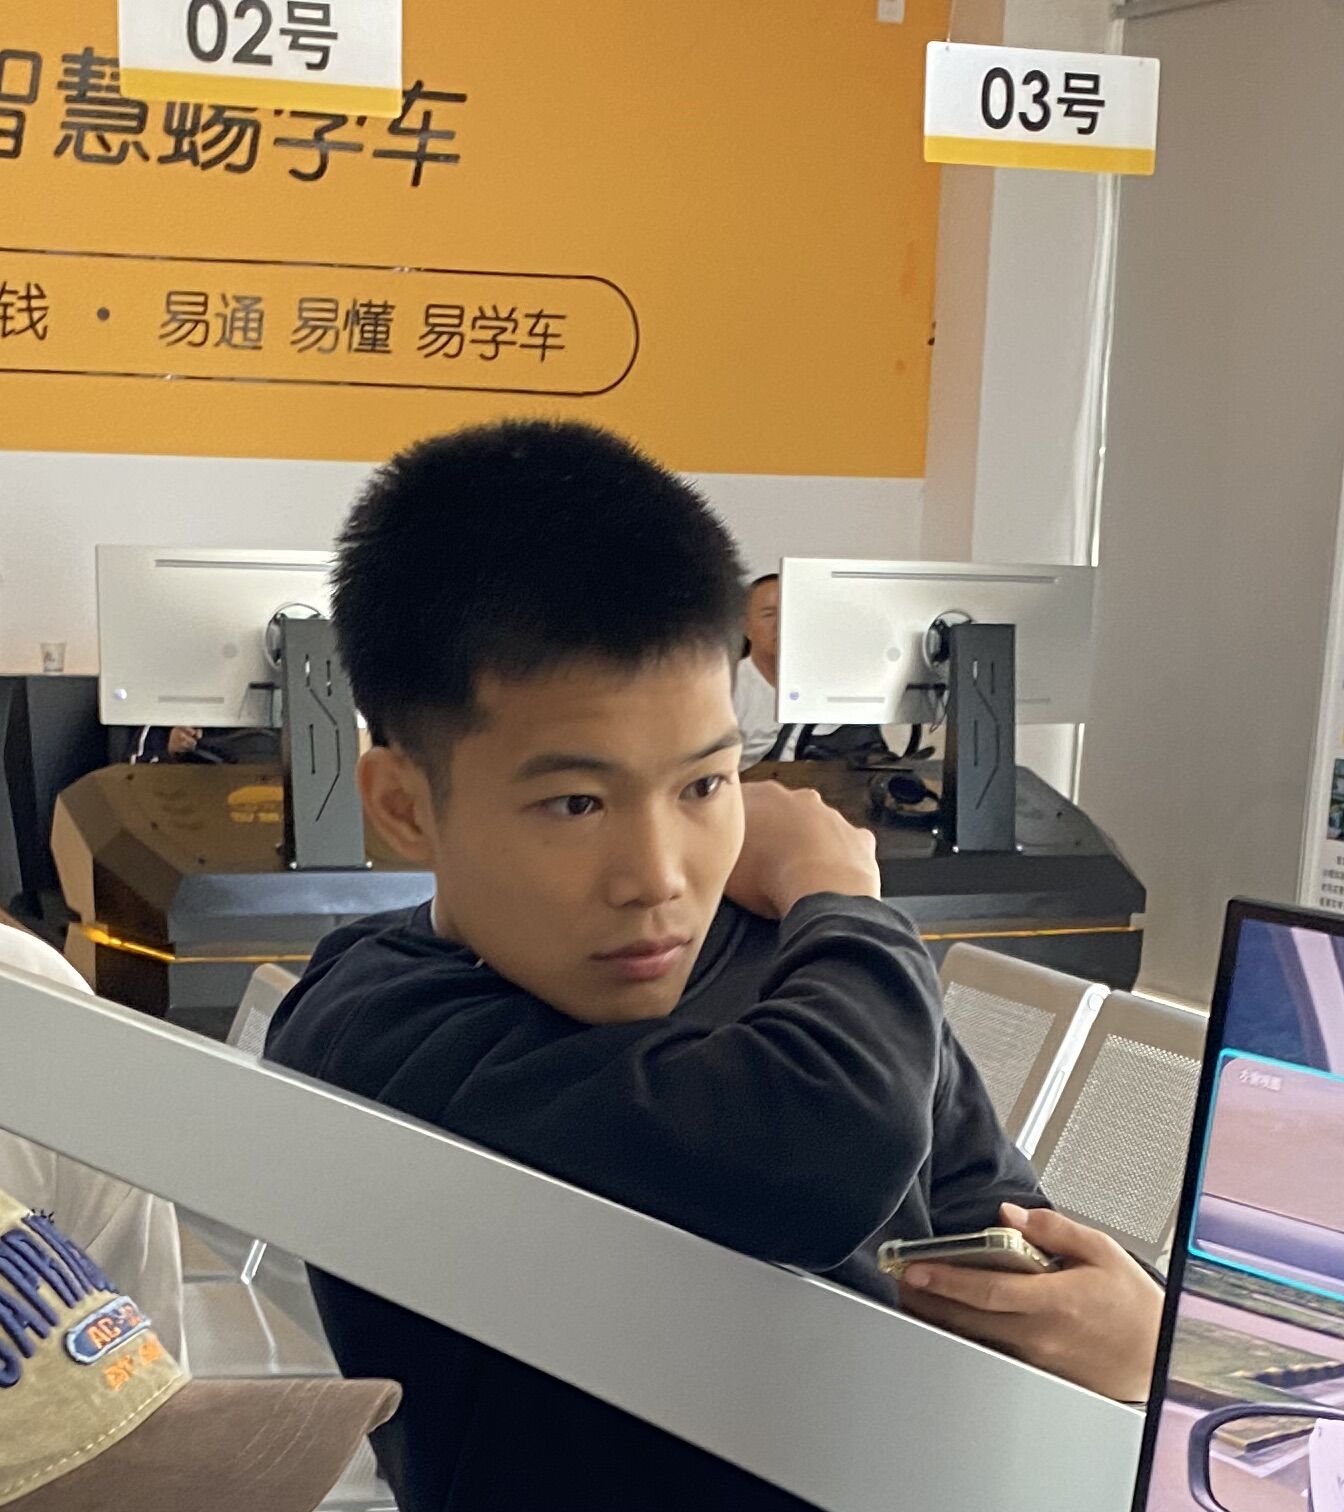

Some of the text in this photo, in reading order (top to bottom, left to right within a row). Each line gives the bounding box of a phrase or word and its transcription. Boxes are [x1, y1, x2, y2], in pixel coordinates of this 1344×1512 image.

[186, 0, 339, 71] 02号
[981, 67, 1106, 135] 03号
[159, 291, 265, 351] 易通
[290, 298, 397, 355] 易懂
[417, 304, 567, 363] 易学车
